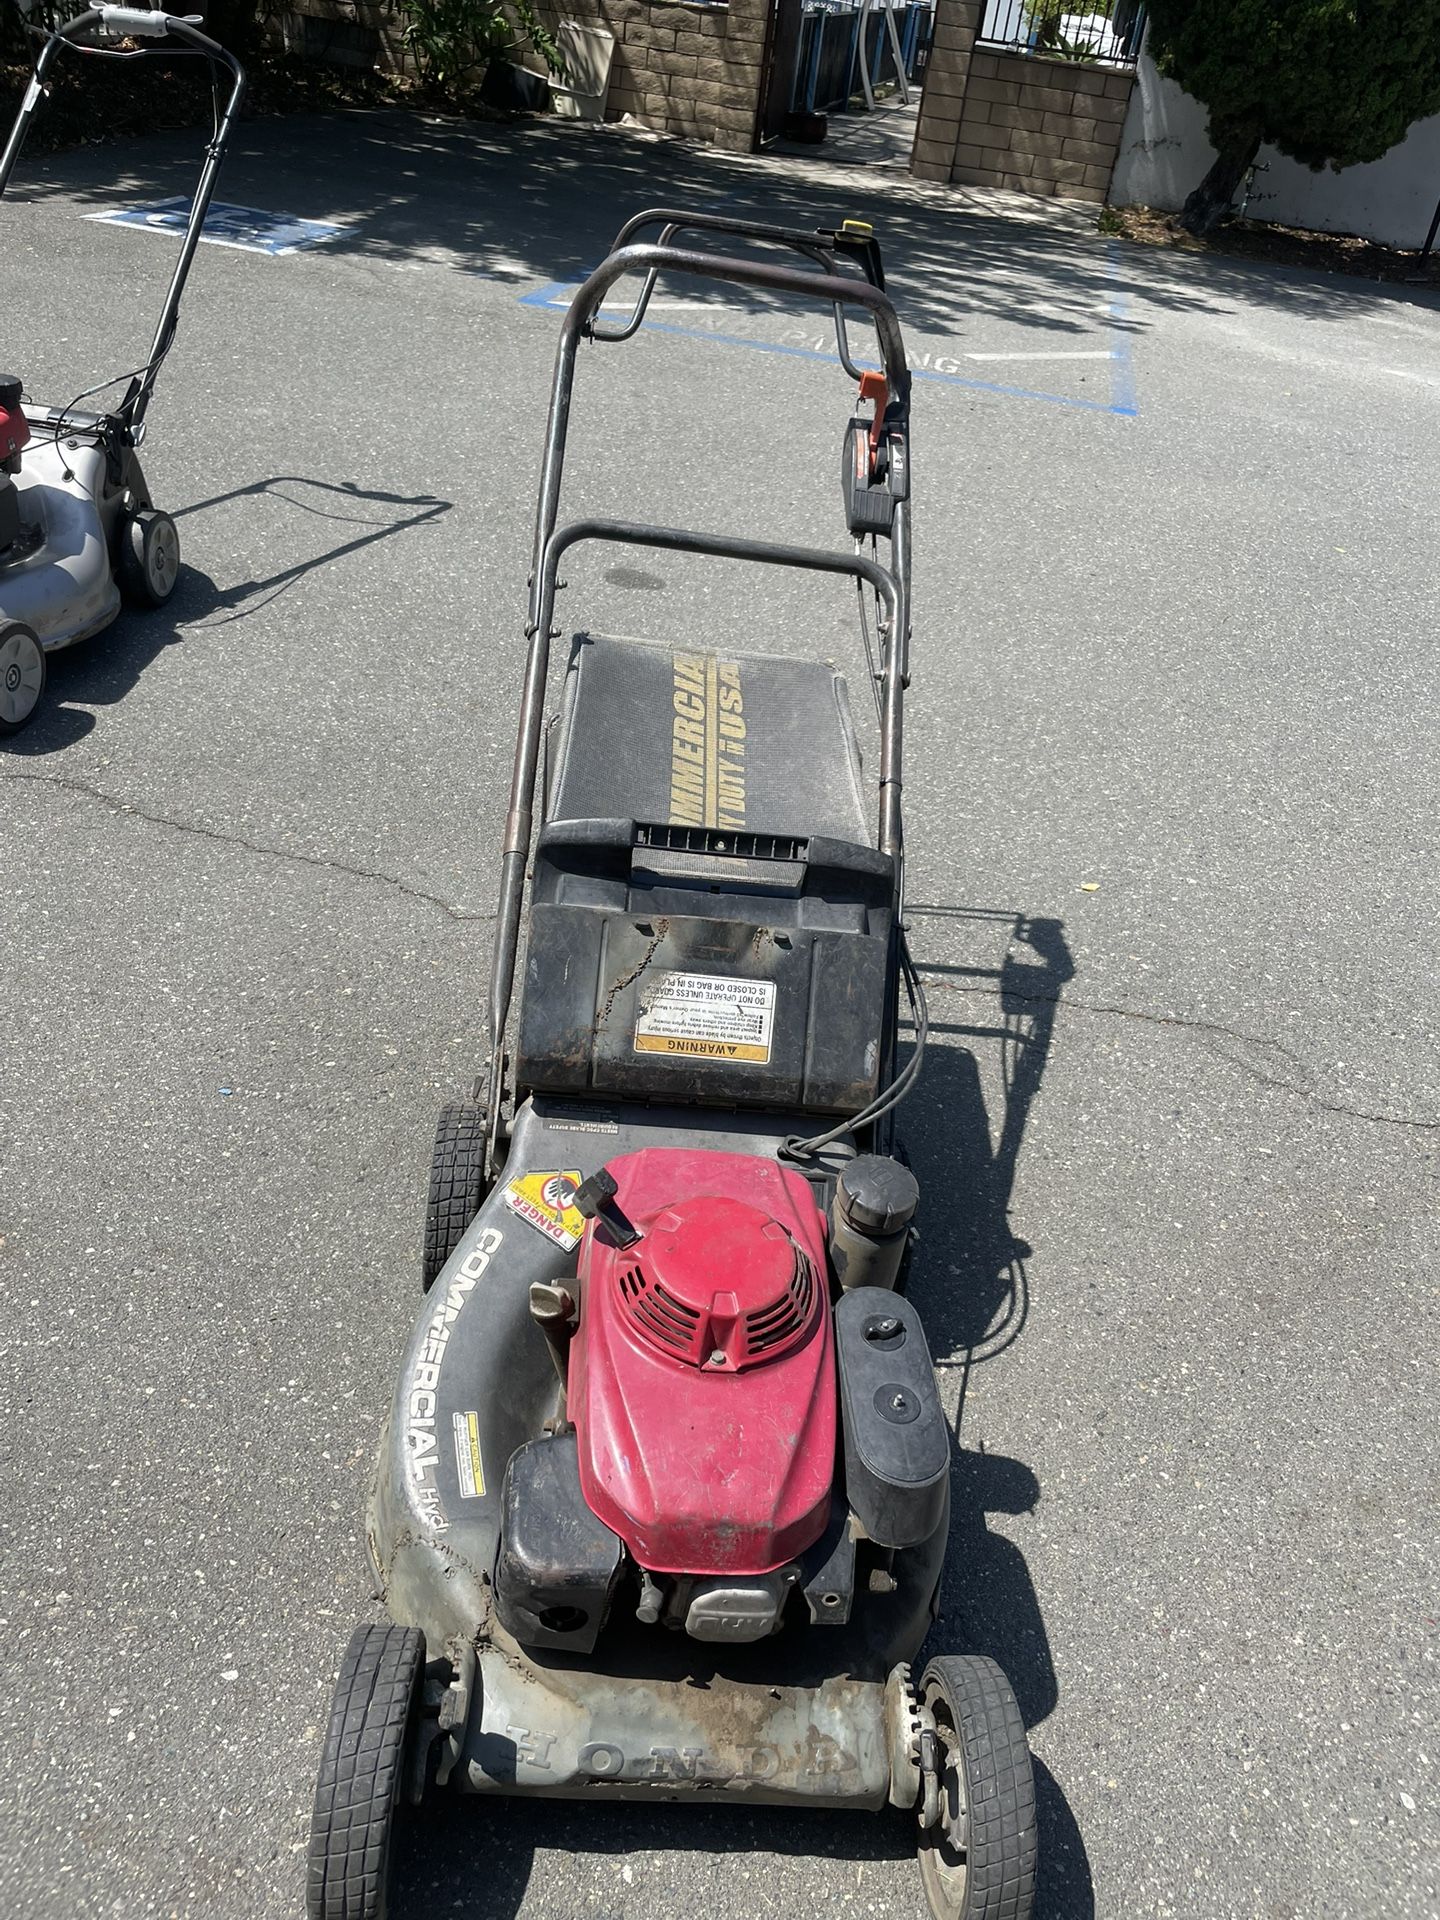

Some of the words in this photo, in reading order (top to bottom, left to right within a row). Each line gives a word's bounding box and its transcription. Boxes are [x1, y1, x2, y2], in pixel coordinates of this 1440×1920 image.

[718, 663, 746, 739] USA
[718, 758, 746, 812] DUTY
[677, 979, 685, 987] IN
[687, 980, 694, 988] IS
[696, 981, 711, 990] BAG
[714, 983, 724, 991] OR
[675, 988, 703, 998] UNLESS
[726, 984, 756, 994] CLOSED
[758, 987, 765, 995] IS
[705, 991, 736, 1002] OPERATE
[738, 995, 752, 1003] NOT
[754, 996, 764, 1004] DO
[743, 1034, 761, 1042] Objects
[667, 1040, 725, 1054] WARNING
[512, 1196, 564, 1238] DANGER
[409, 1227, 504, 1482] COMMERCIAL
[505, 1724, 858, 1780] HONDA
